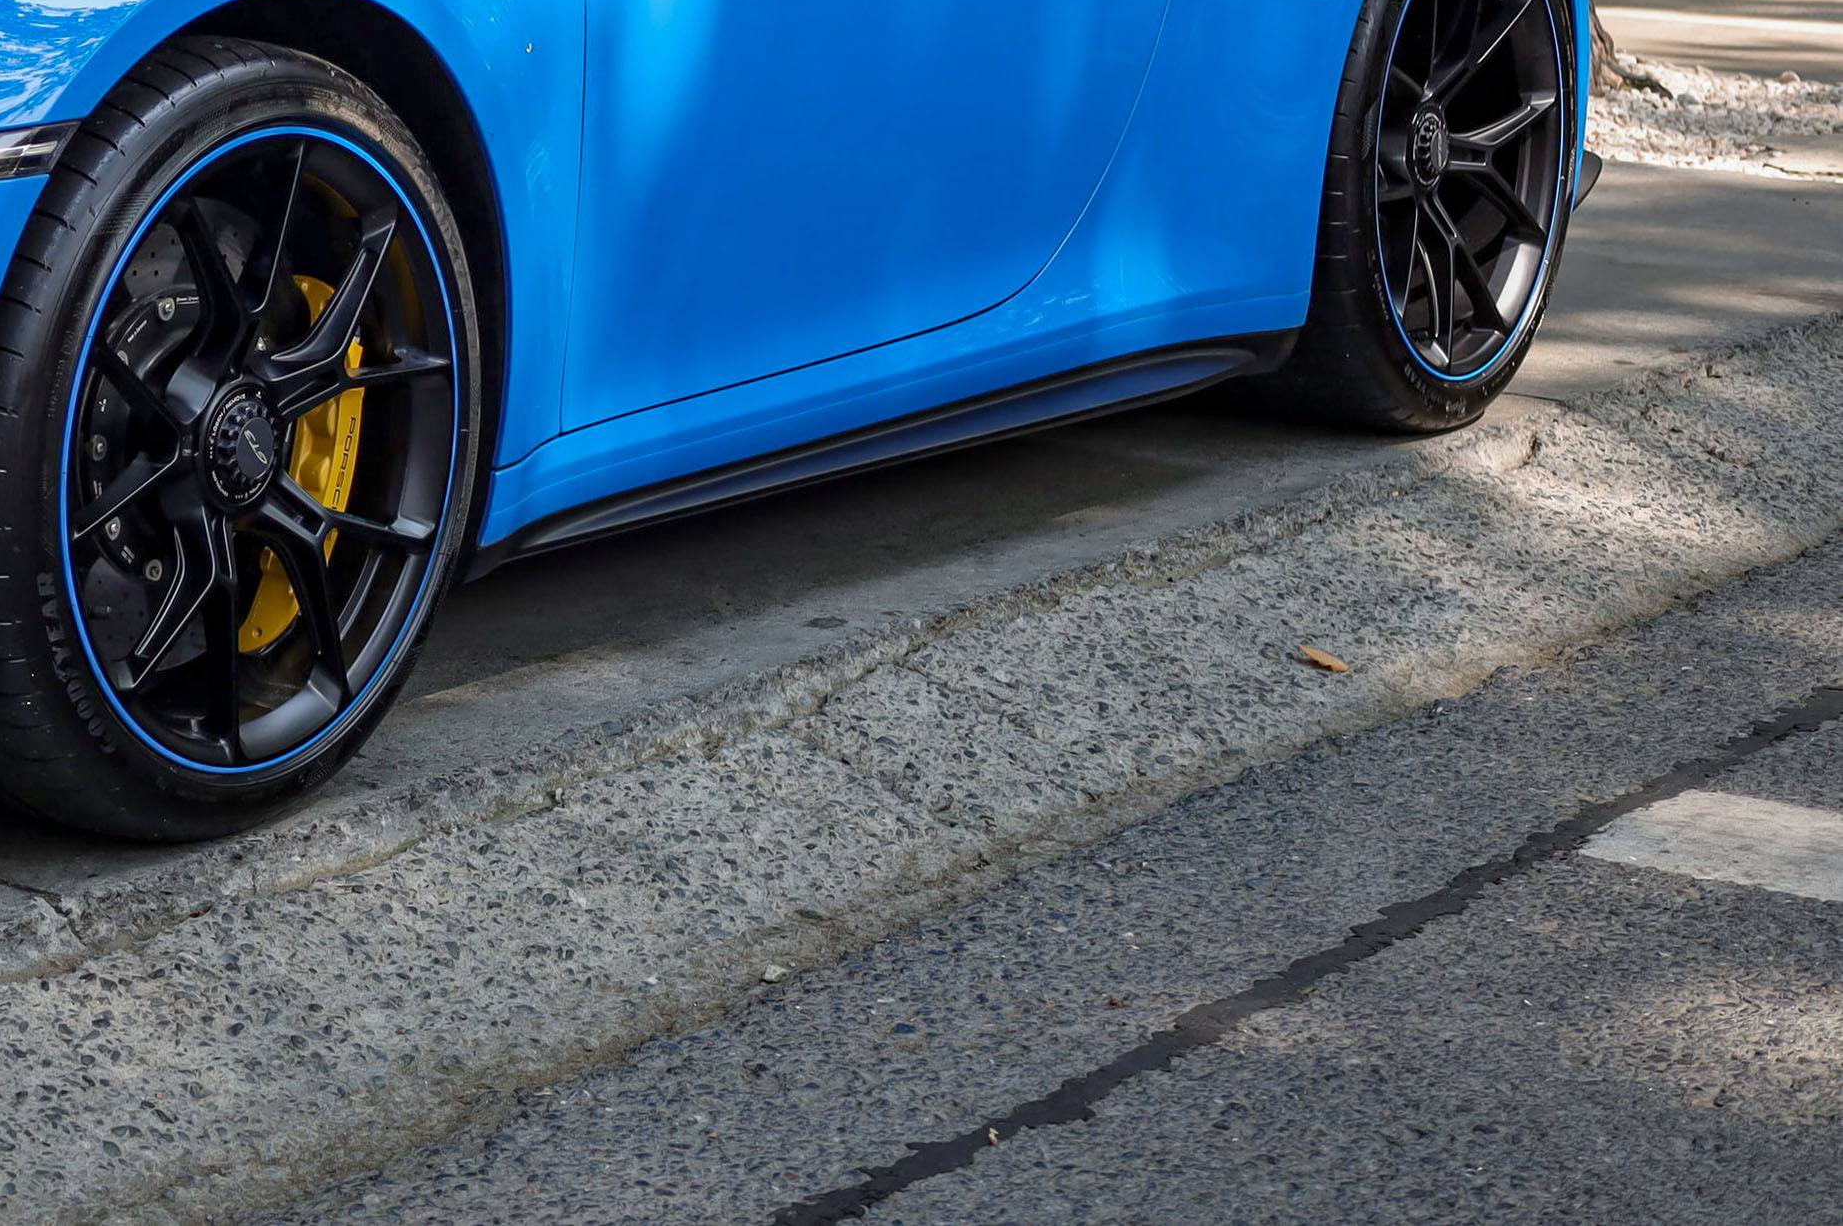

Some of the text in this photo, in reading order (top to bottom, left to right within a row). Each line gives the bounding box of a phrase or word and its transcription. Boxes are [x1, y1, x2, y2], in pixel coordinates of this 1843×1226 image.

[244, 429, 268, 465] GT3
[326, 416, 357, 541] PORSC
[37, 572, 117, 754] GOODYEAR
